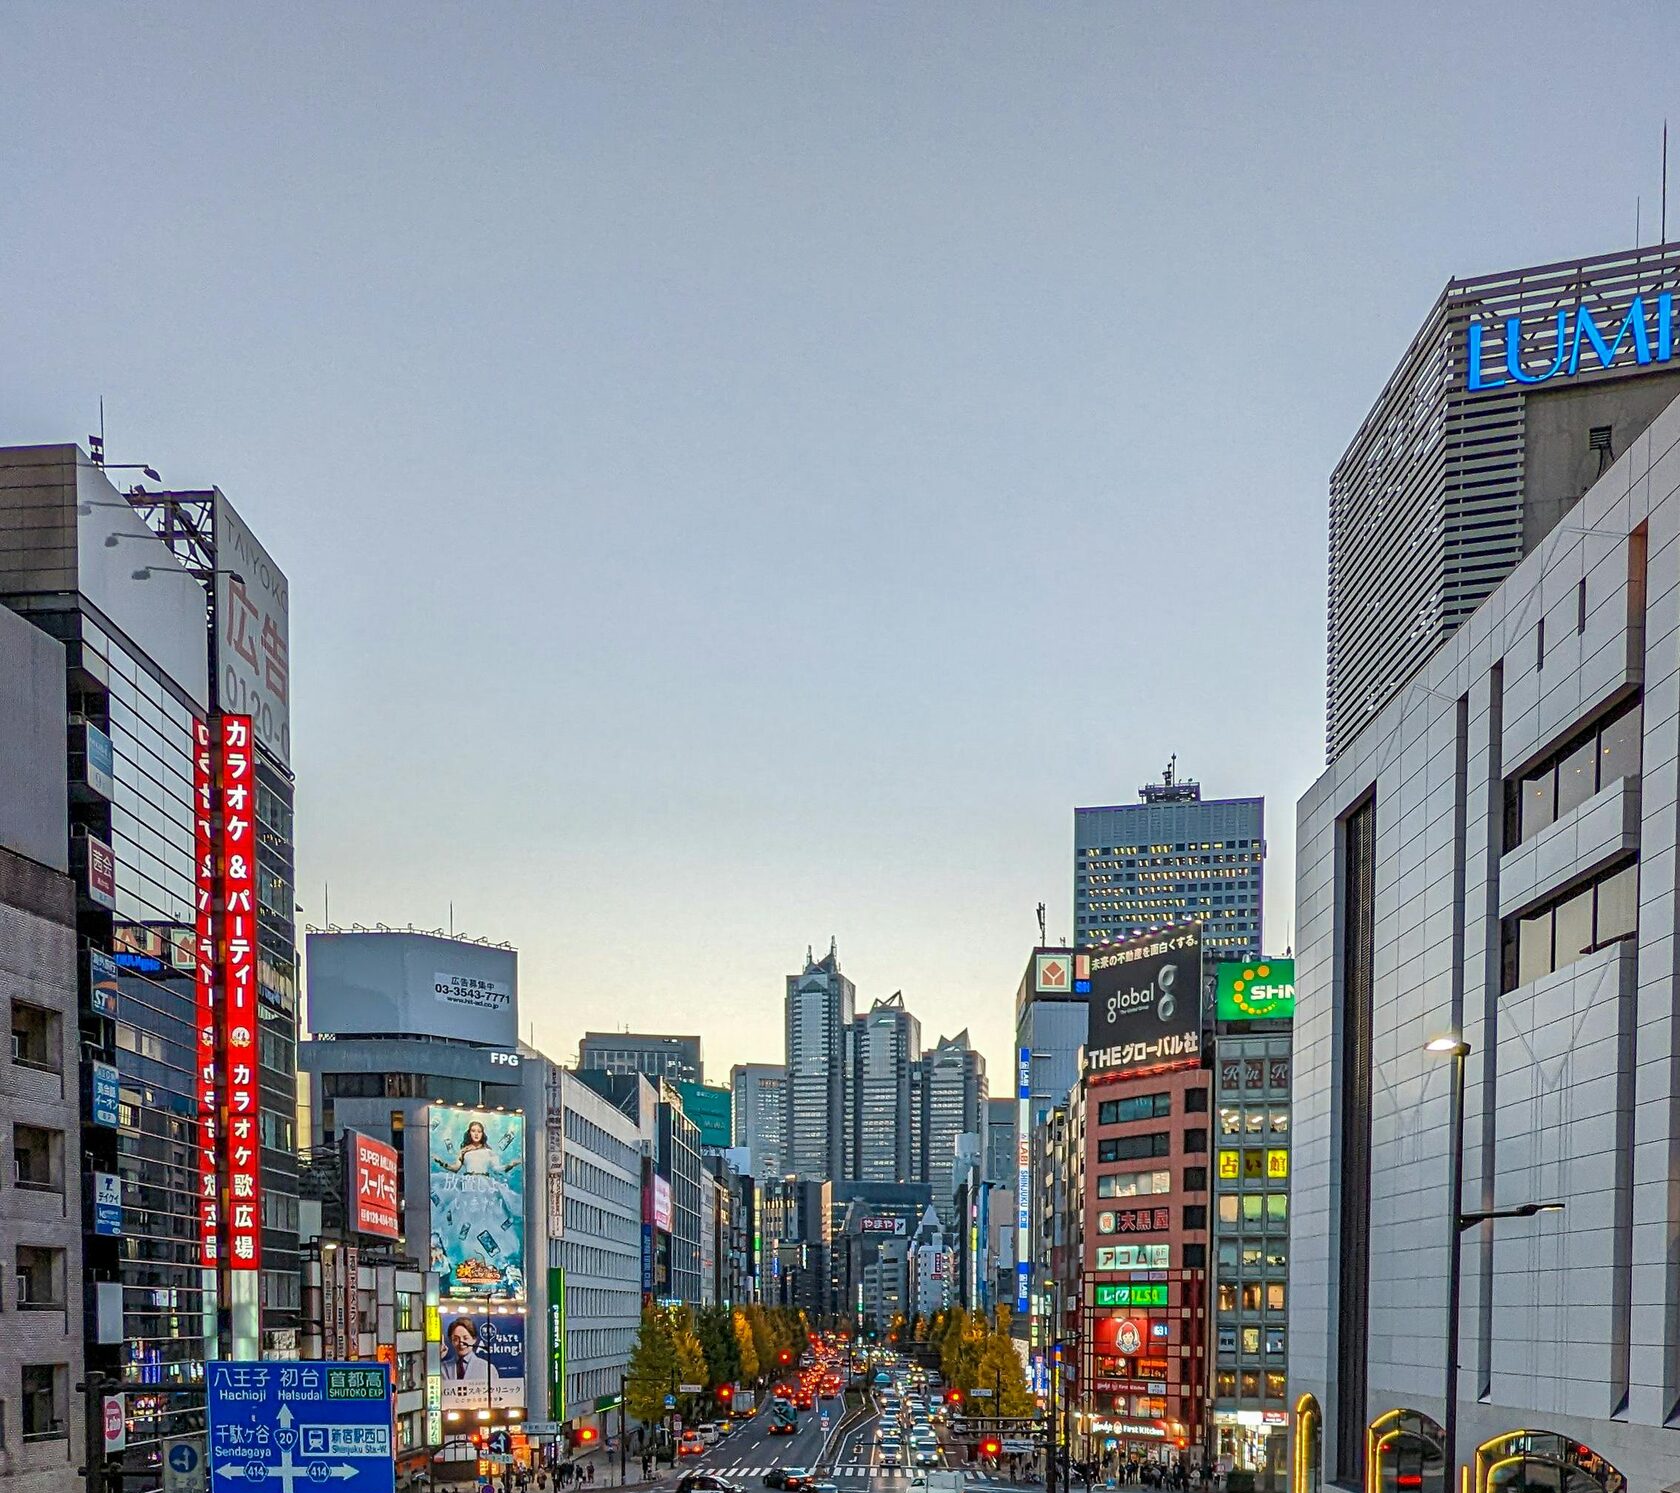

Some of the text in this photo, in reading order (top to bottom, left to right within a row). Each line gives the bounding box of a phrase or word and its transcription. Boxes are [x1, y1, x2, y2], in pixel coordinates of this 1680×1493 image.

[451, 976, 495, 991] 広告募集中
[435, 983, 510, 1004] 03-3543-7771
[1088, 1031, 1198, 1069] THEグローバル社
[490, 1052, 519, 1066] FPG
[1020, 1141, 1028, 1166] LABI
[233, 1063, 254, 1260] カラオケ歌広場
[864, 1219, 893, 1229] やまや
[1120, 1209, 1169, 1231] 大黒屋
[1102, 1251, 1148, 1266] アコム
[214, 1368, 320, 1387] 八王子 初台
[329, 1371, 383, 1388] 首都高
[219, 1389, 323, 1402] Hachioji Hatsudai
[329, 1388, 384, 1398] SHUTOKO EXP
[216, 1424, 269, 1444] 千駄ヶ谷
[279, 1432, 293, 1445] 20
[331, 1428, 387, 1444] 新宿駅西口
[215, 1445, 272, 1459] Sendagaya
[248, 1466, 264, 1477] 414
[310, 1466, 327, 1477] 414
